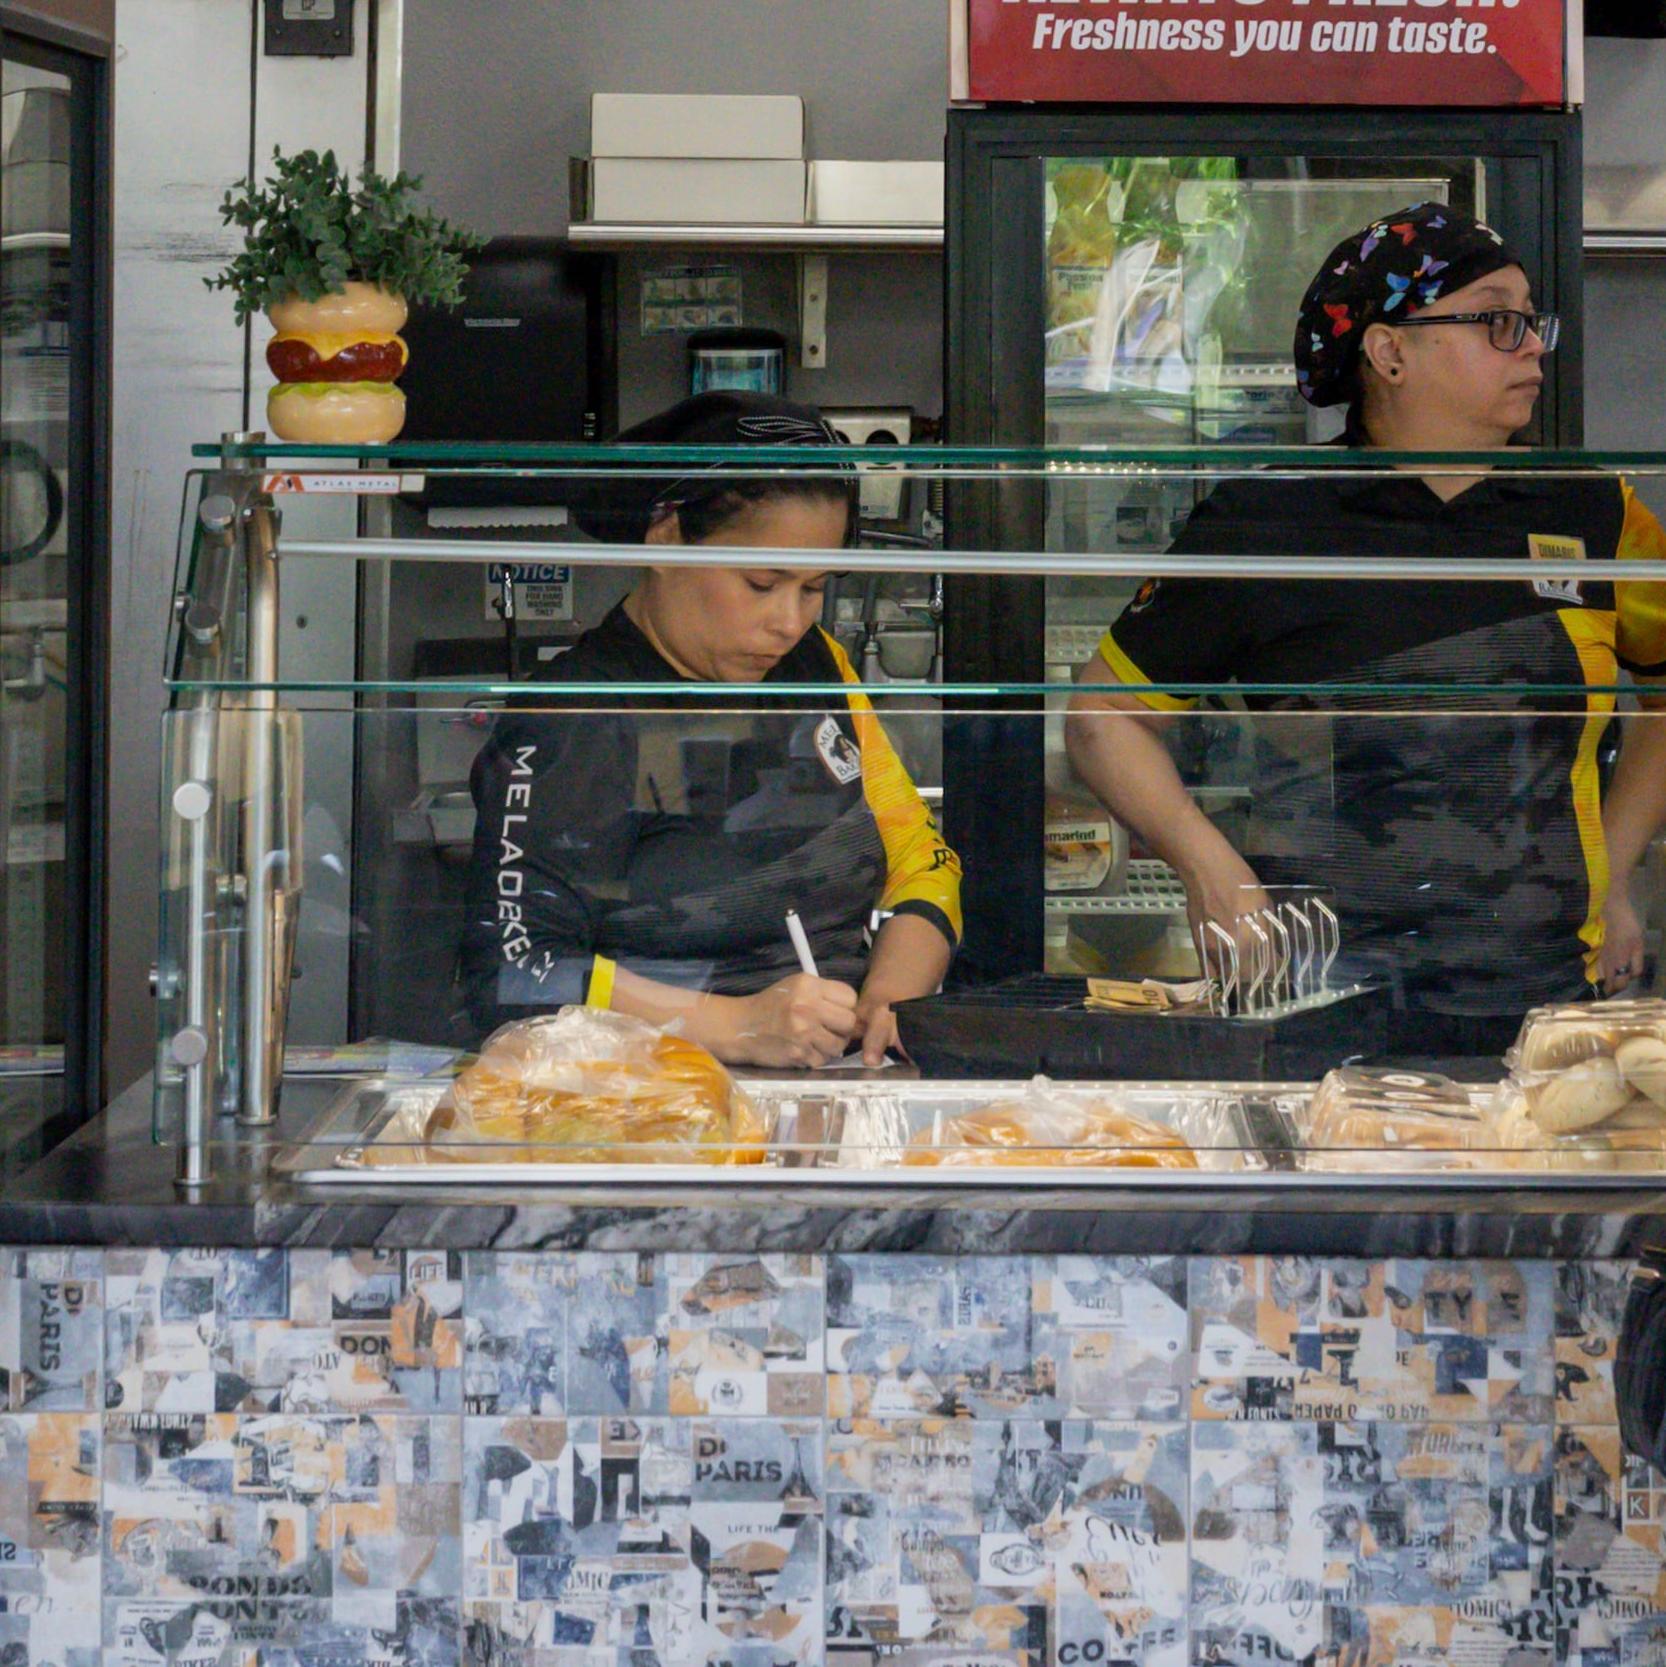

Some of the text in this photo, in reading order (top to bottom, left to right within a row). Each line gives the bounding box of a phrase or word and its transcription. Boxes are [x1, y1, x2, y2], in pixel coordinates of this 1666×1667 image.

[1032, 12, 1498, 57] Freshness you can taste.
